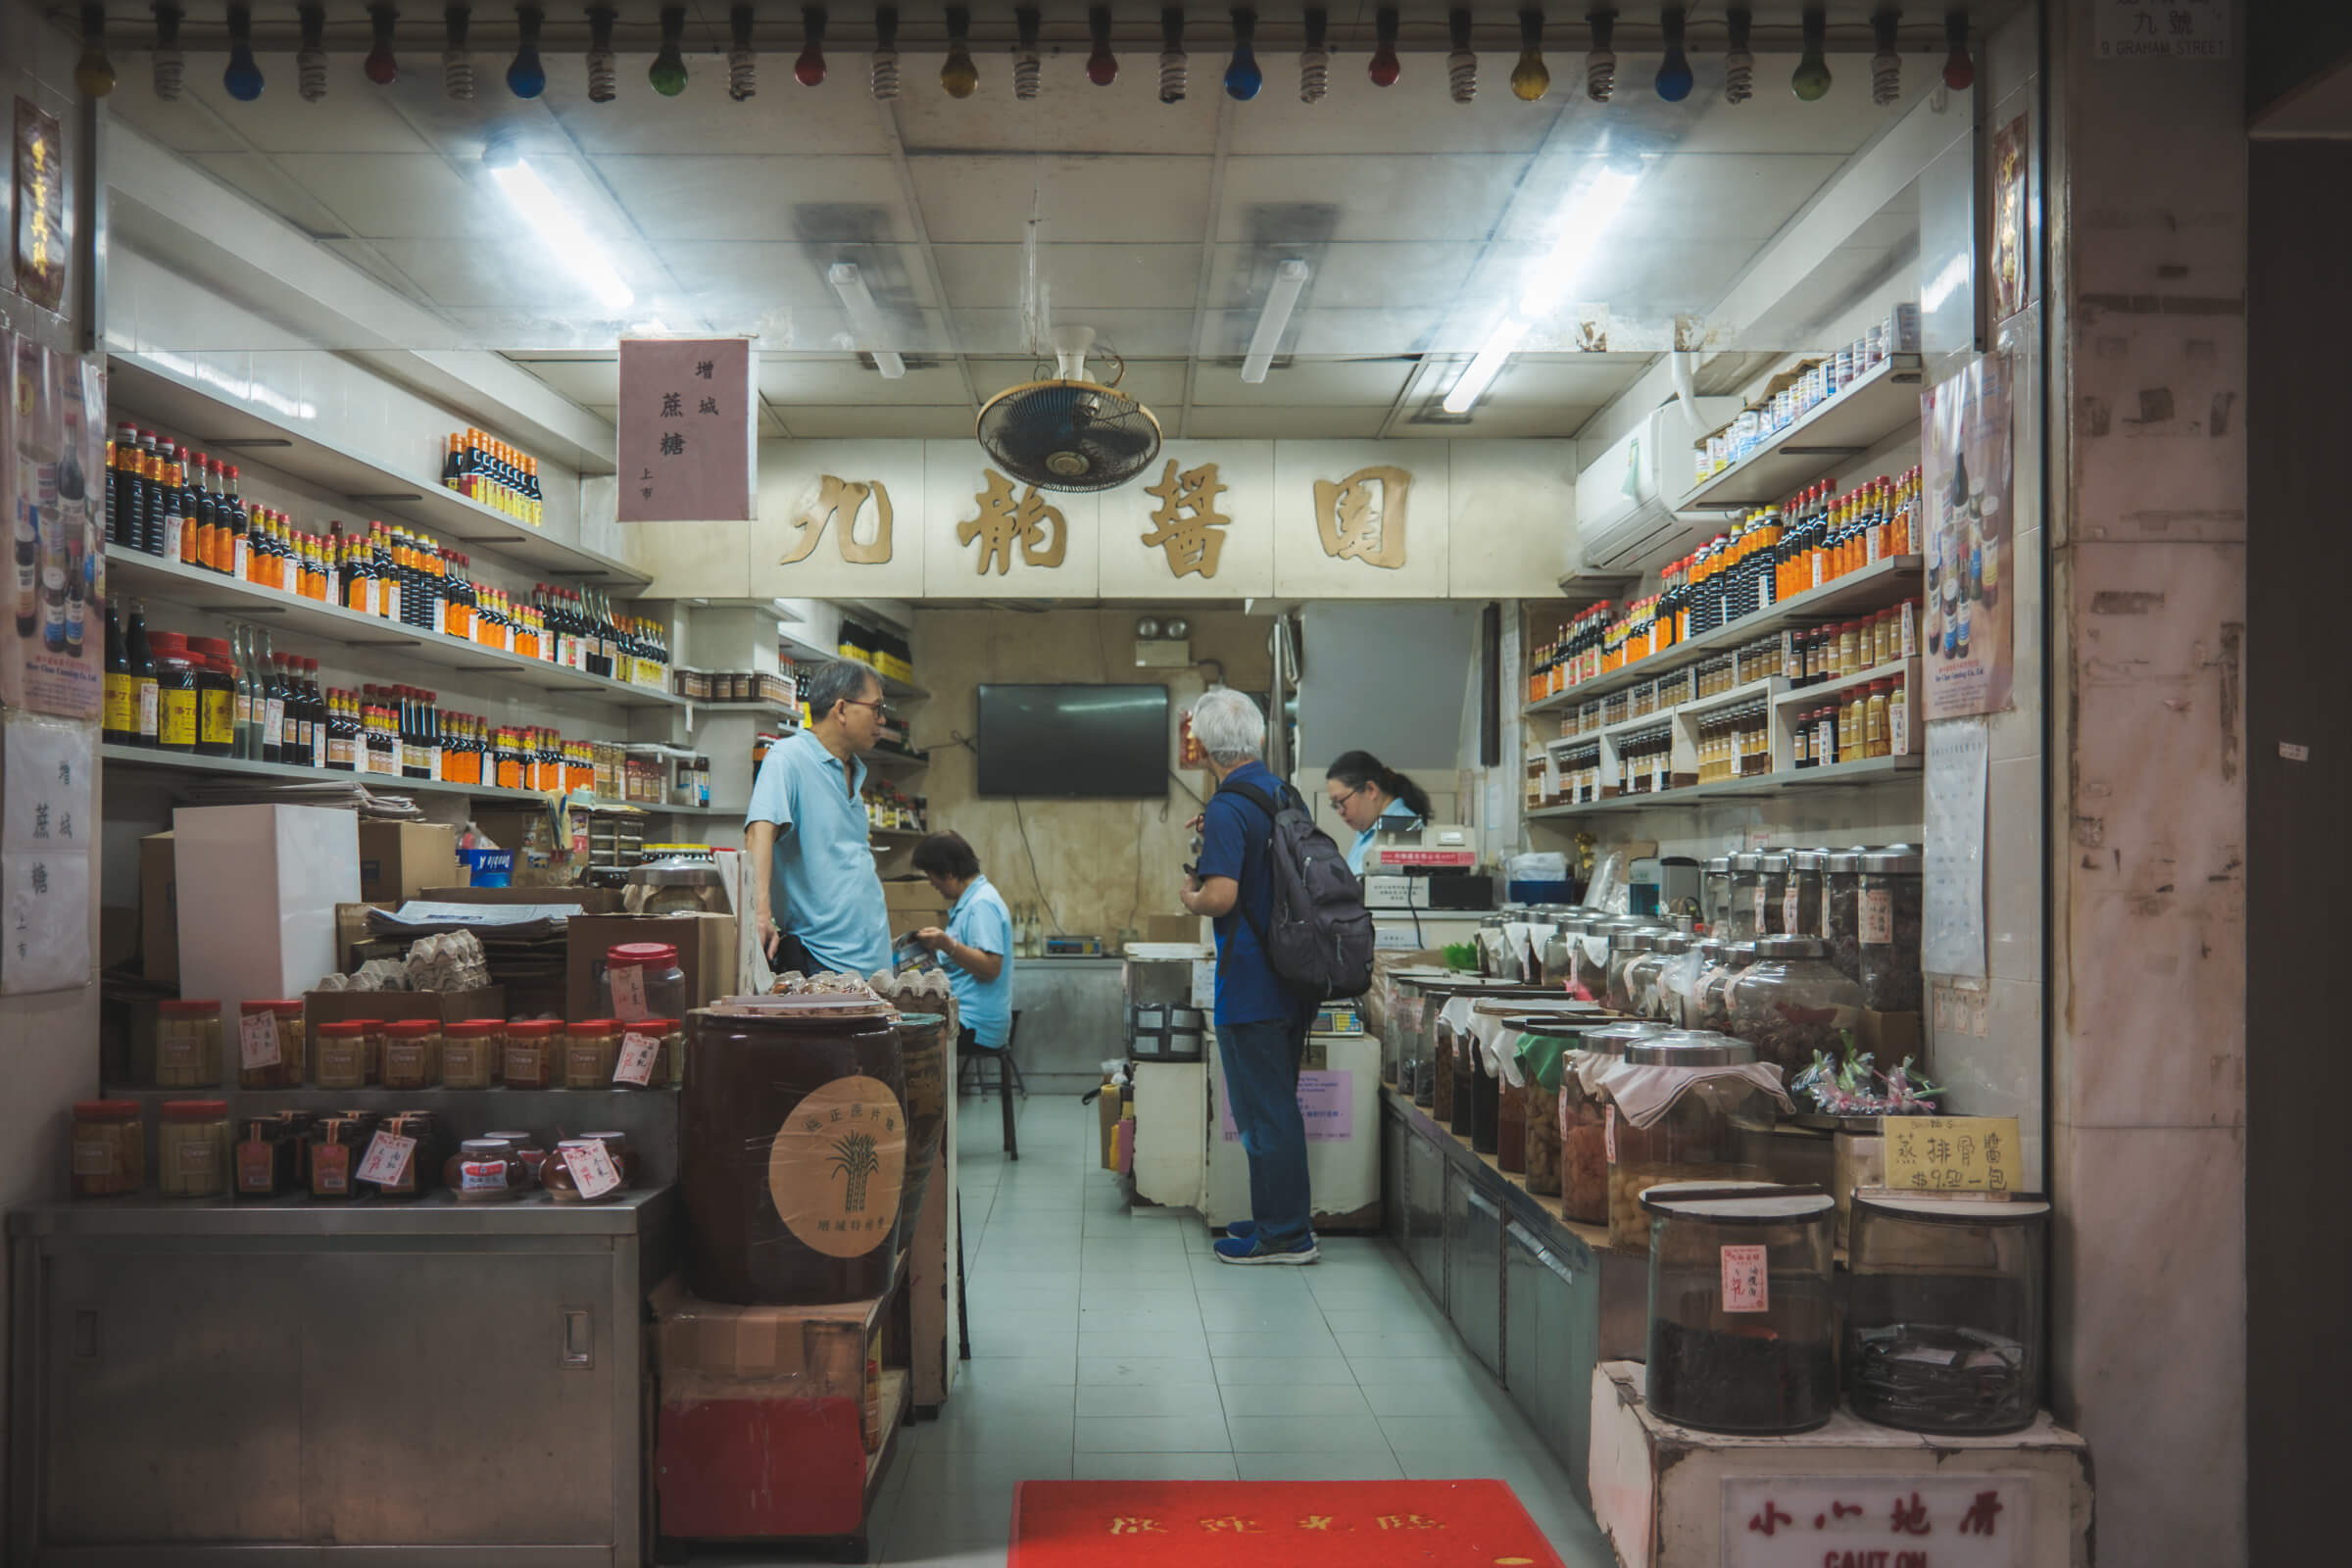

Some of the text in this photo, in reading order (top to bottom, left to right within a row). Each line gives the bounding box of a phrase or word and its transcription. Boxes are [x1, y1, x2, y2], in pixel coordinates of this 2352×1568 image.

[2101, 40, 2226, 56] 9 GRAHAM STREET
[695, 361, 719, 416] 增城
[660, 392, 686, 457] 蔗糖
[640, 467, 655, 501] 上市
